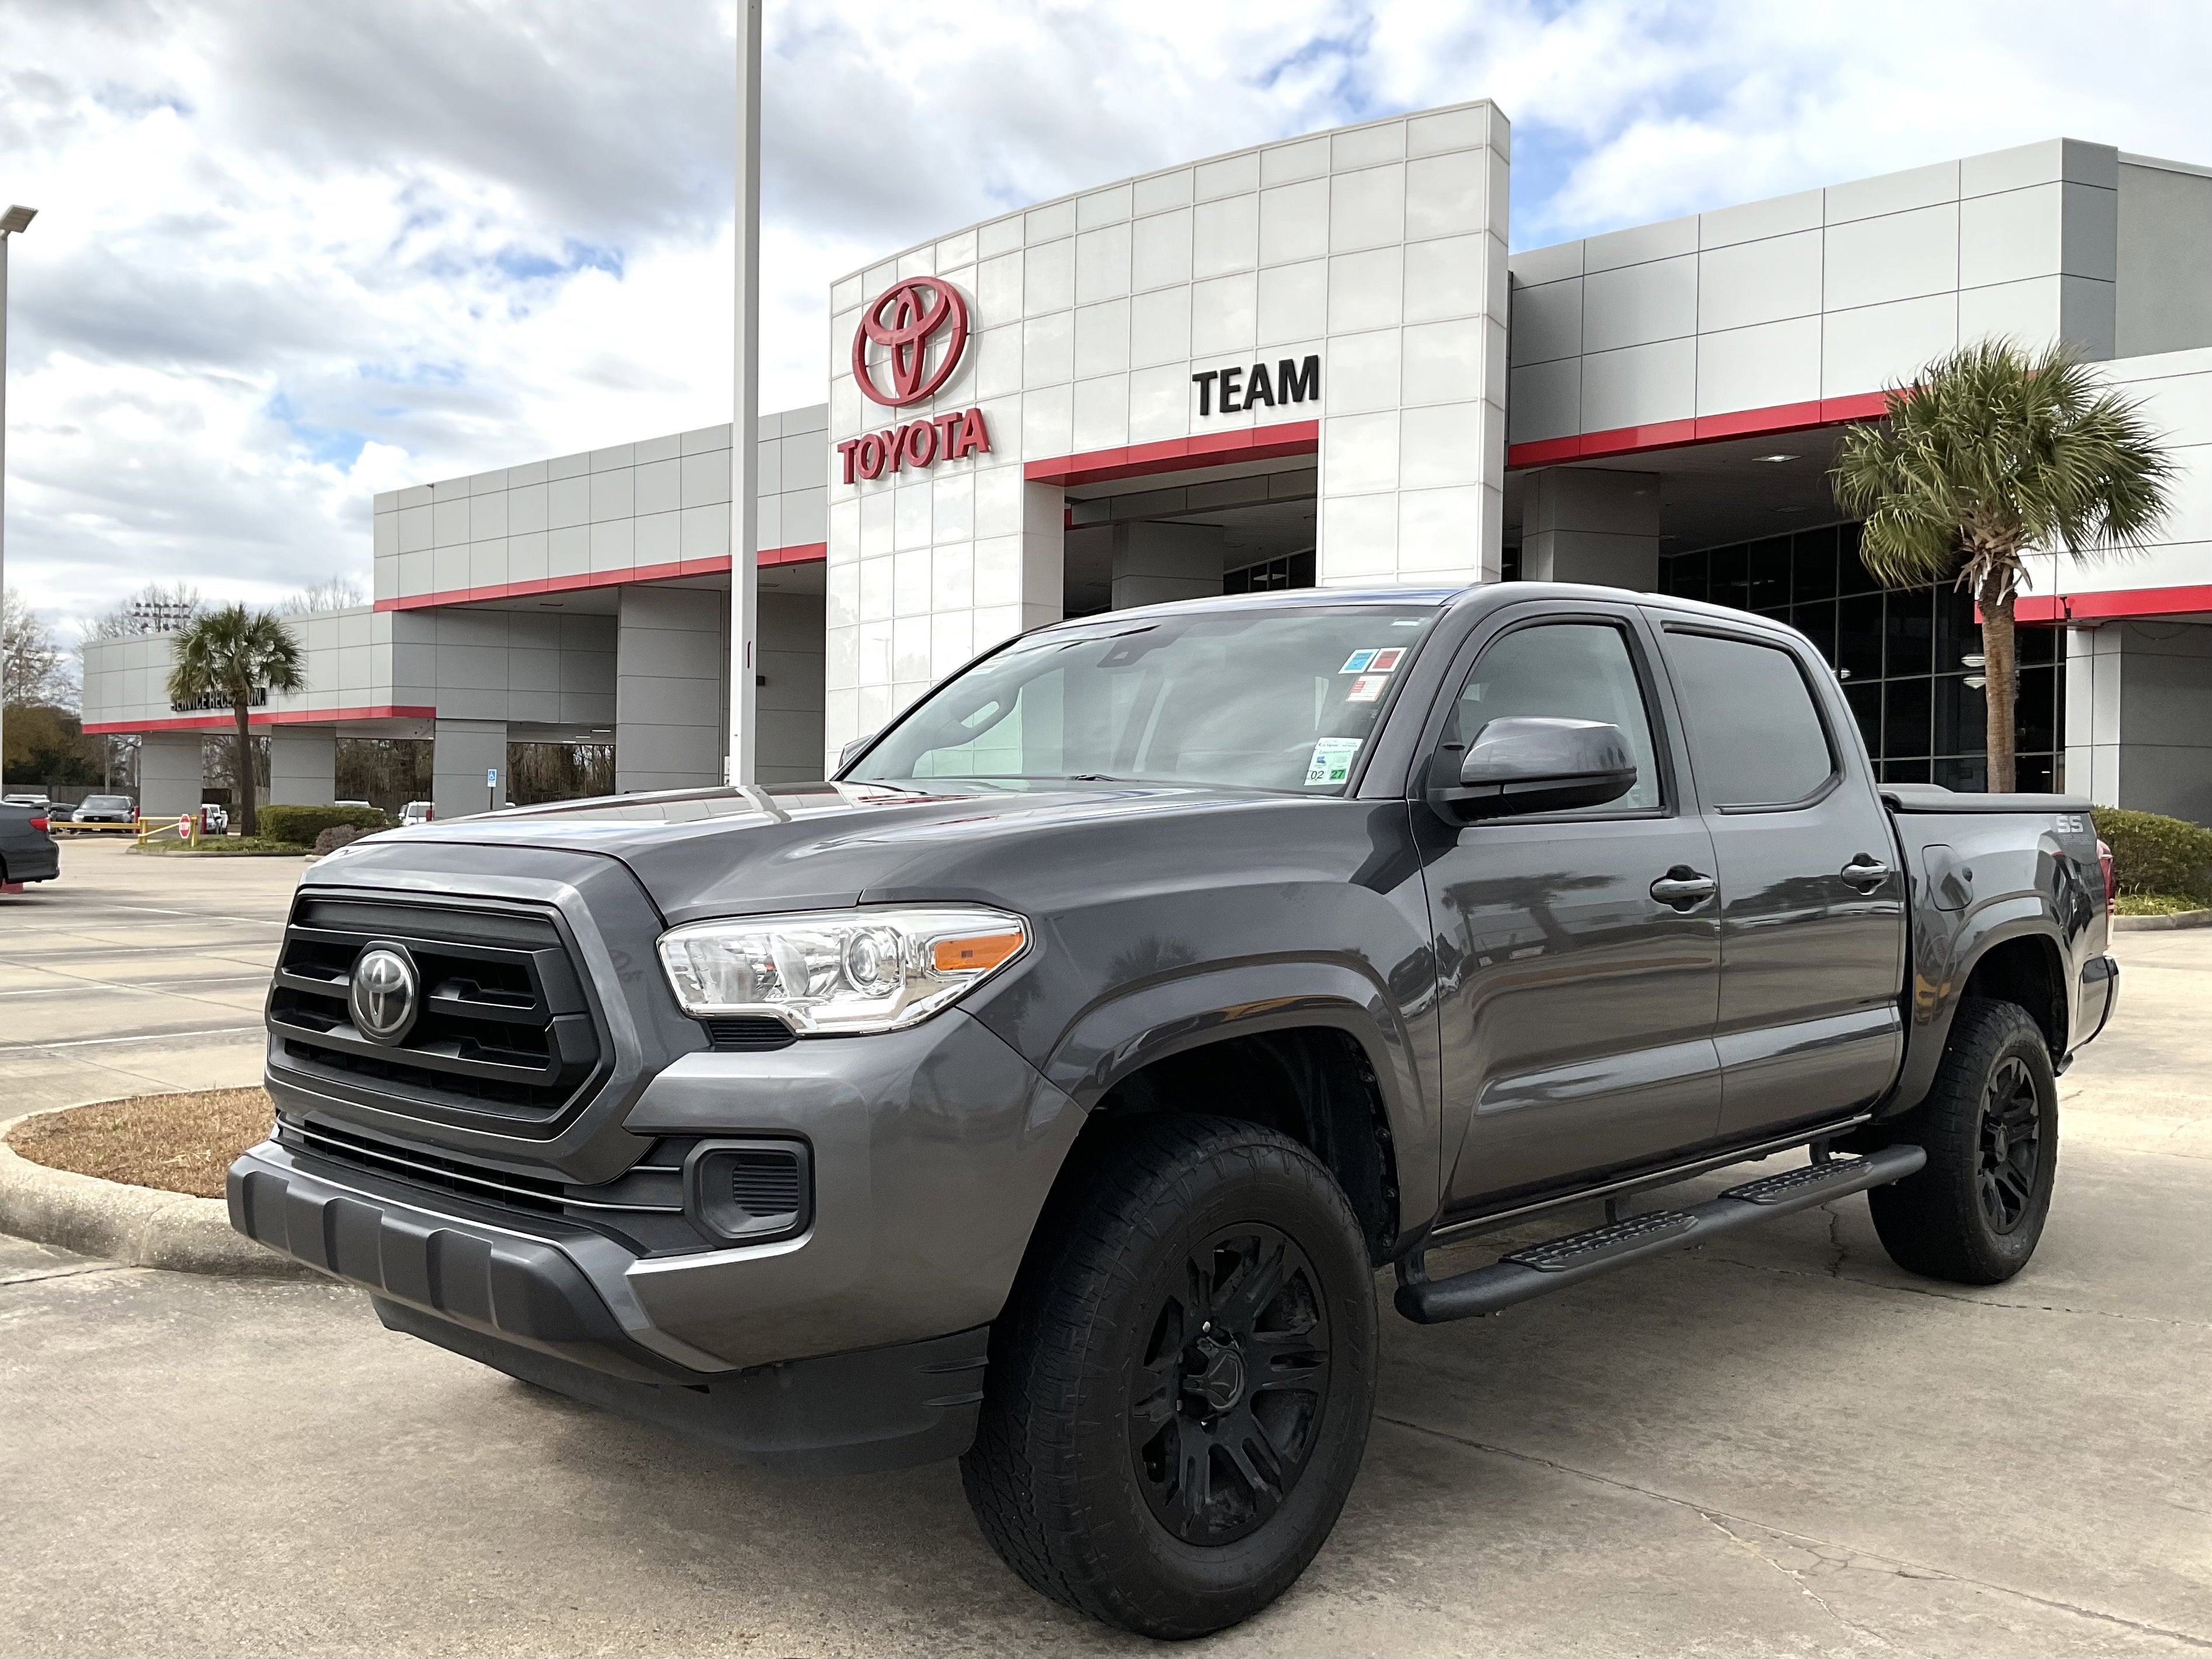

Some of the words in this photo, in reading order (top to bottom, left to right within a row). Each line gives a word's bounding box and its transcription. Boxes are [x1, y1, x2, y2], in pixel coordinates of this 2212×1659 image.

[1192, 354, 1319, 416] TEAM
[837, 408, 990, 485] TOYOTA
[1311, 771, 1324, 780] 02
[1331, 770, 1345, 779] 27
